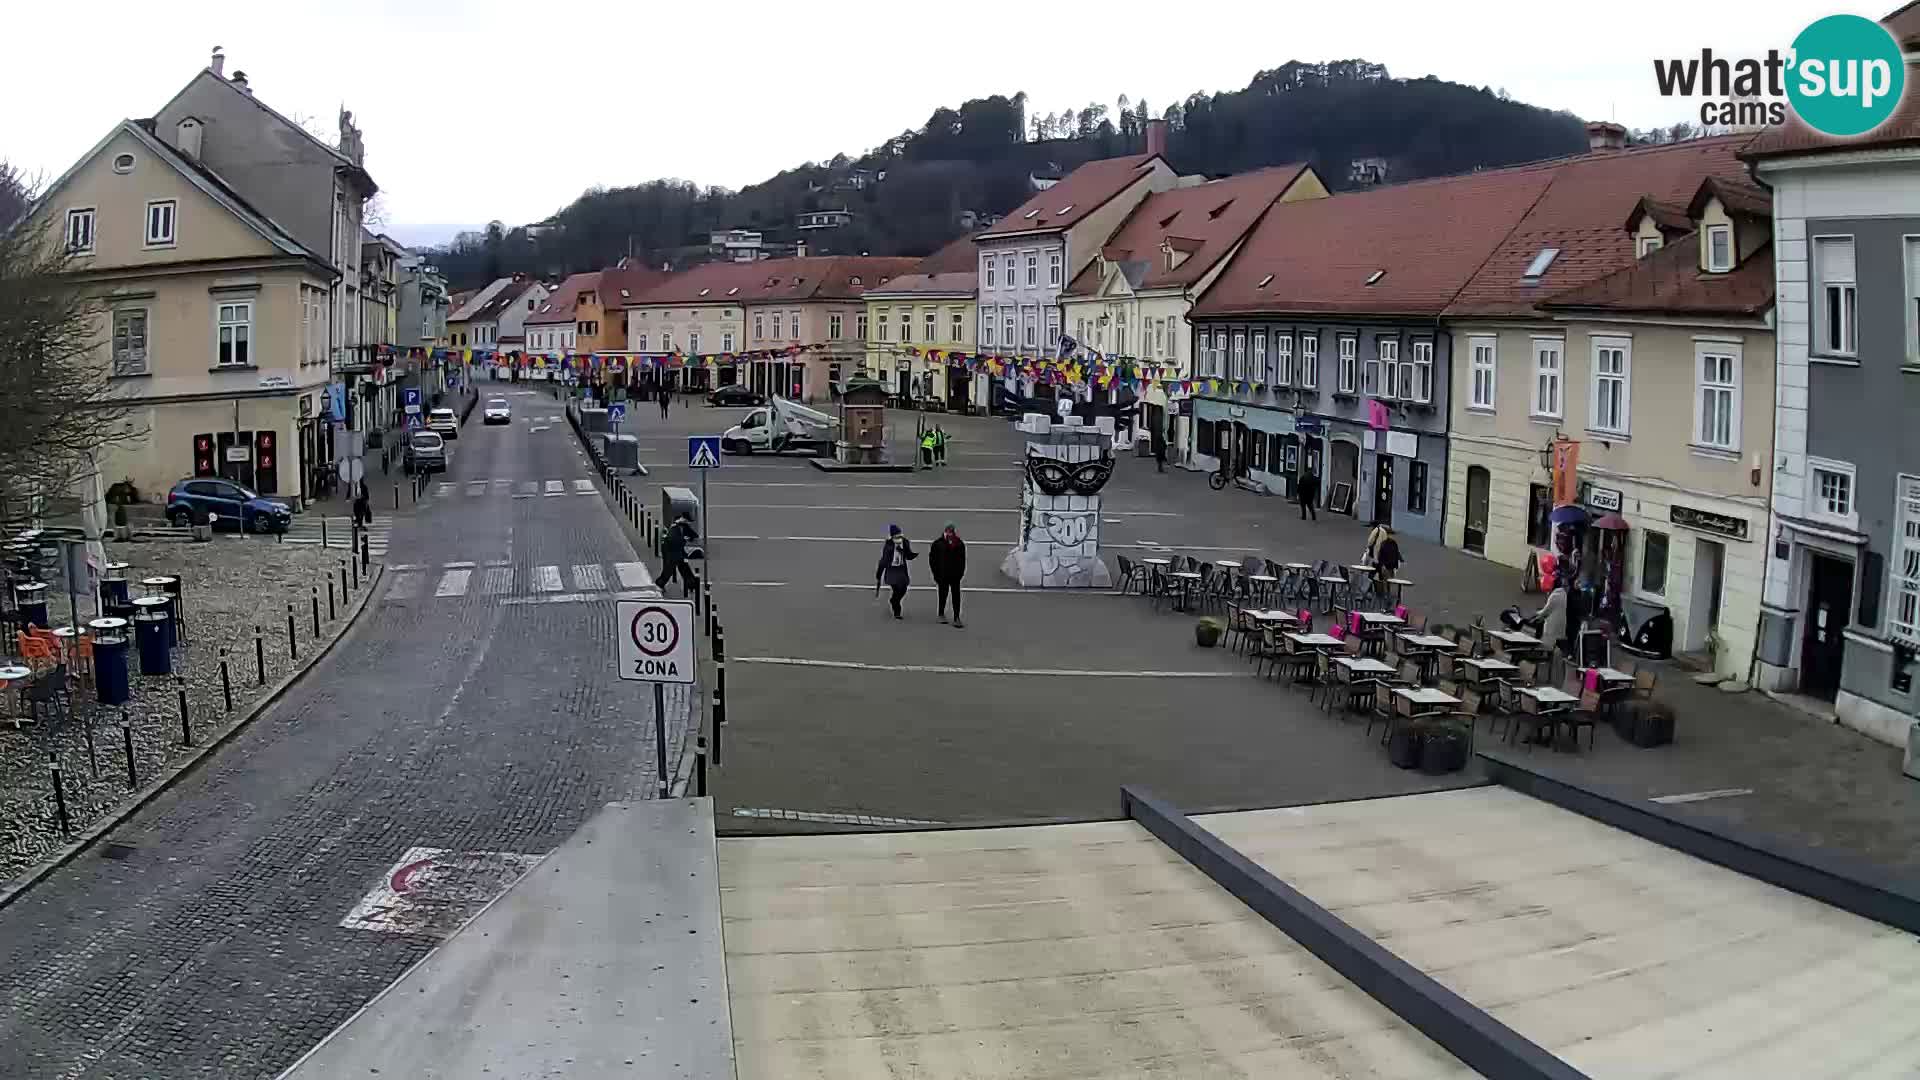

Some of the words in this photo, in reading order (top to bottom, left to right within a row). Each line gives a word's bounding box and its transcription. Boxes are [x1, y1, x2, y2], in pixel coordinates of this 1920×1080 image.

[408, 391, 416, 402] P
[643, 622, 668, 643] 30
[634, 659, 679, 676] ZONA
